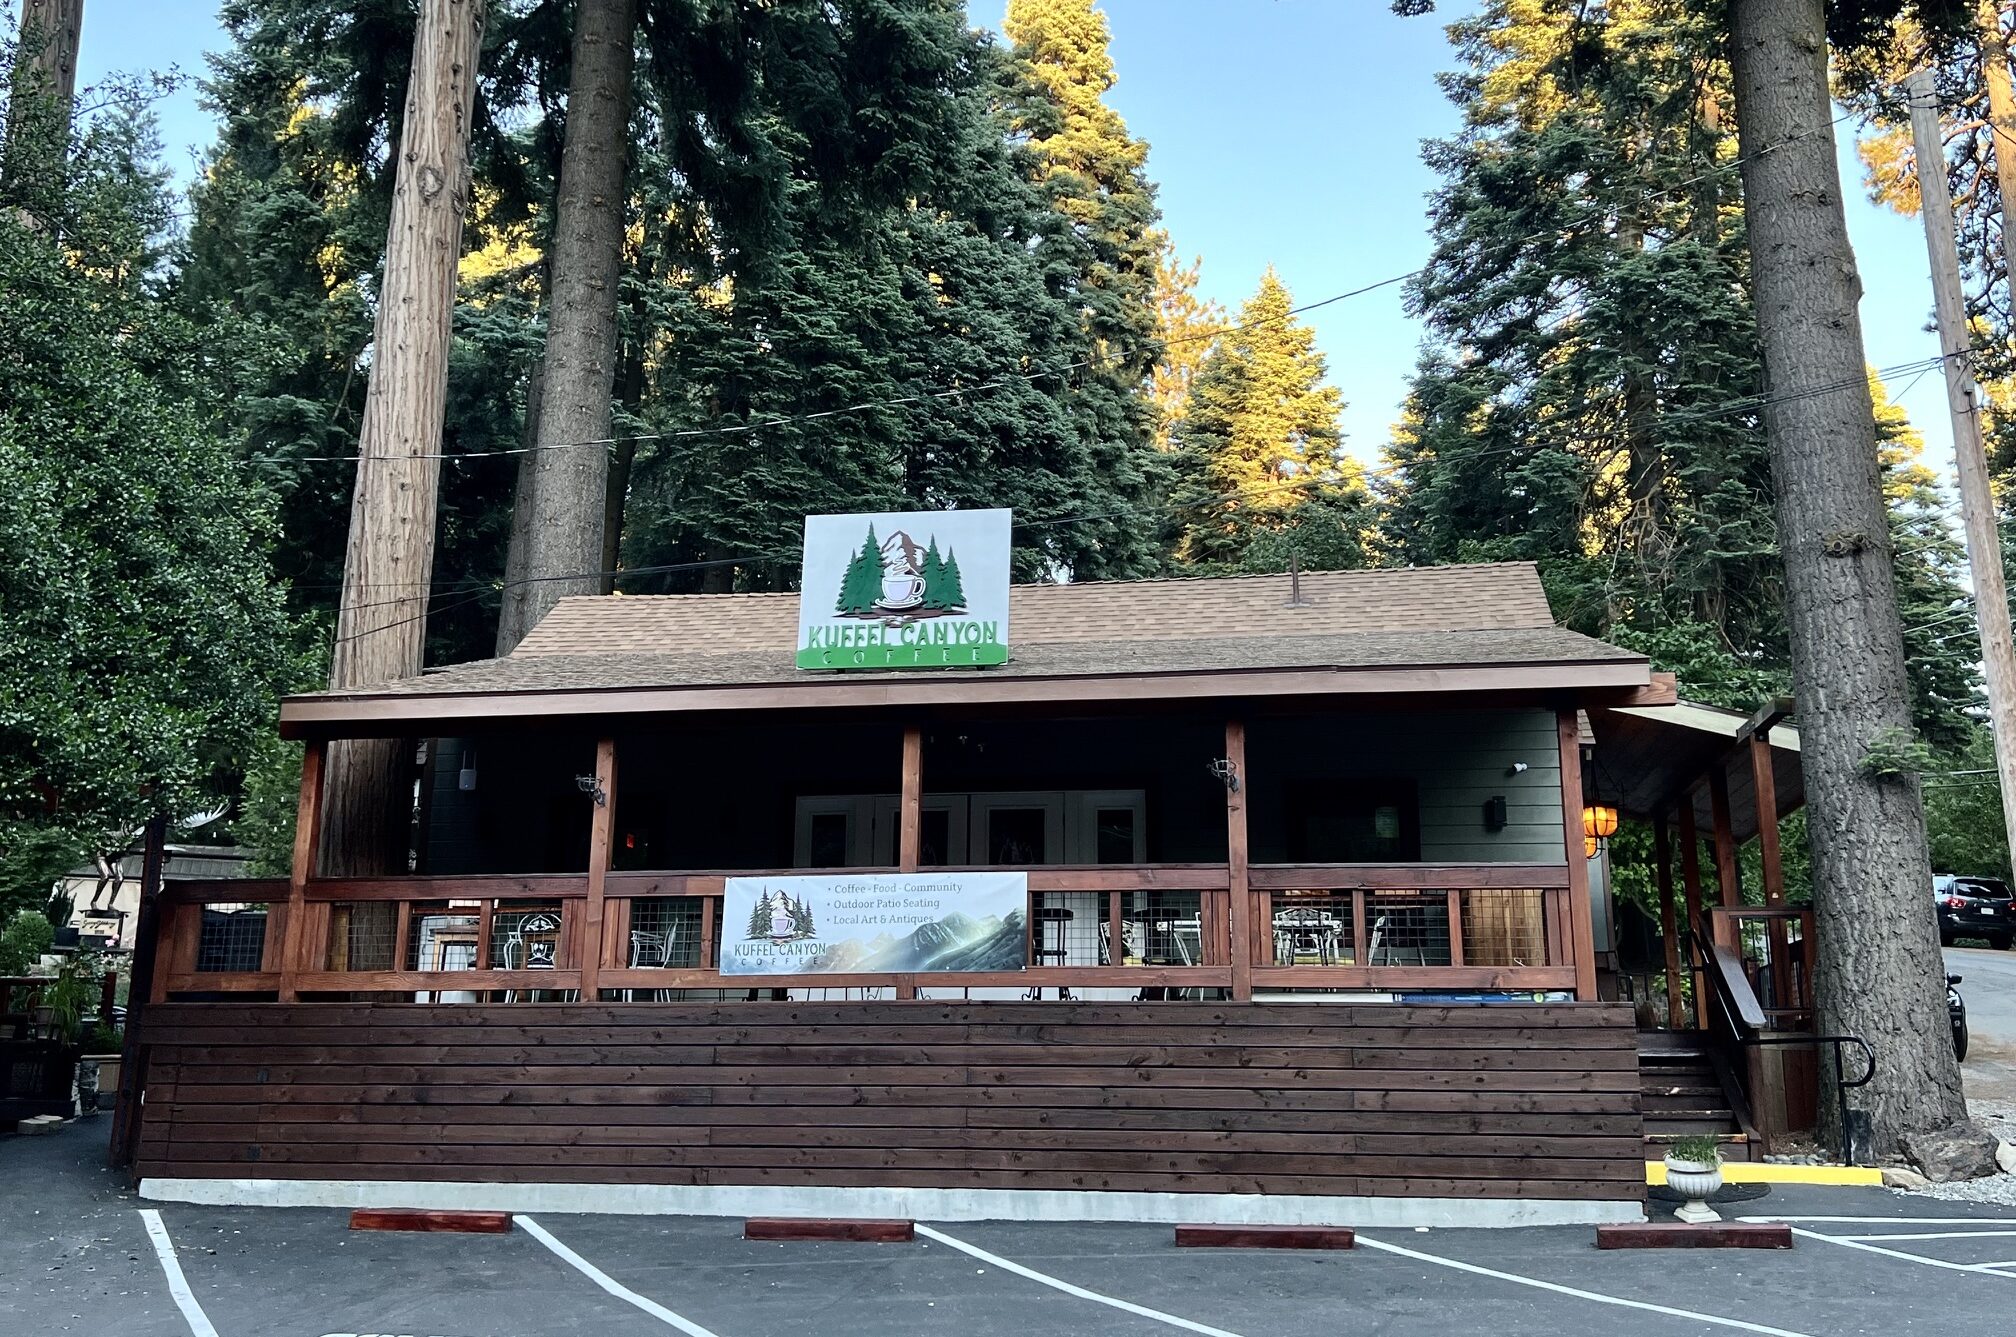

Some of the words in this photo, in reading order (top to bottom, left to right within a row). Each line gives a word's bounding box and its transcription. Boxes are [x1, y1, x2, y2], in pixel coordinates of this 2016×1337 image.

[808, 624, 891, 648] KUFFEL
[900, 621, 998, 646] CANYON
[822, 647, 981, 665] COFFEE
[834, 884, 866, 894] Coffee
[873, 883, 897, 893] Food
[904, 882, 963, 894] Community
[834, 899, 875, 909] Outdoor
[877, 899, 901, 908] Patio
[903, 898, 940, 910] Seating
[833, 915, 859, 925] Local
[861, 915, 878, 924] Art
[880, 915, 887, 924] &
[889, 914, 934, 925] Antiques
[734, 943, 775, 956] KUFFEL
[779, 943, 826, 956] CANYON
[741, 957, 818, 966] COFFEE
